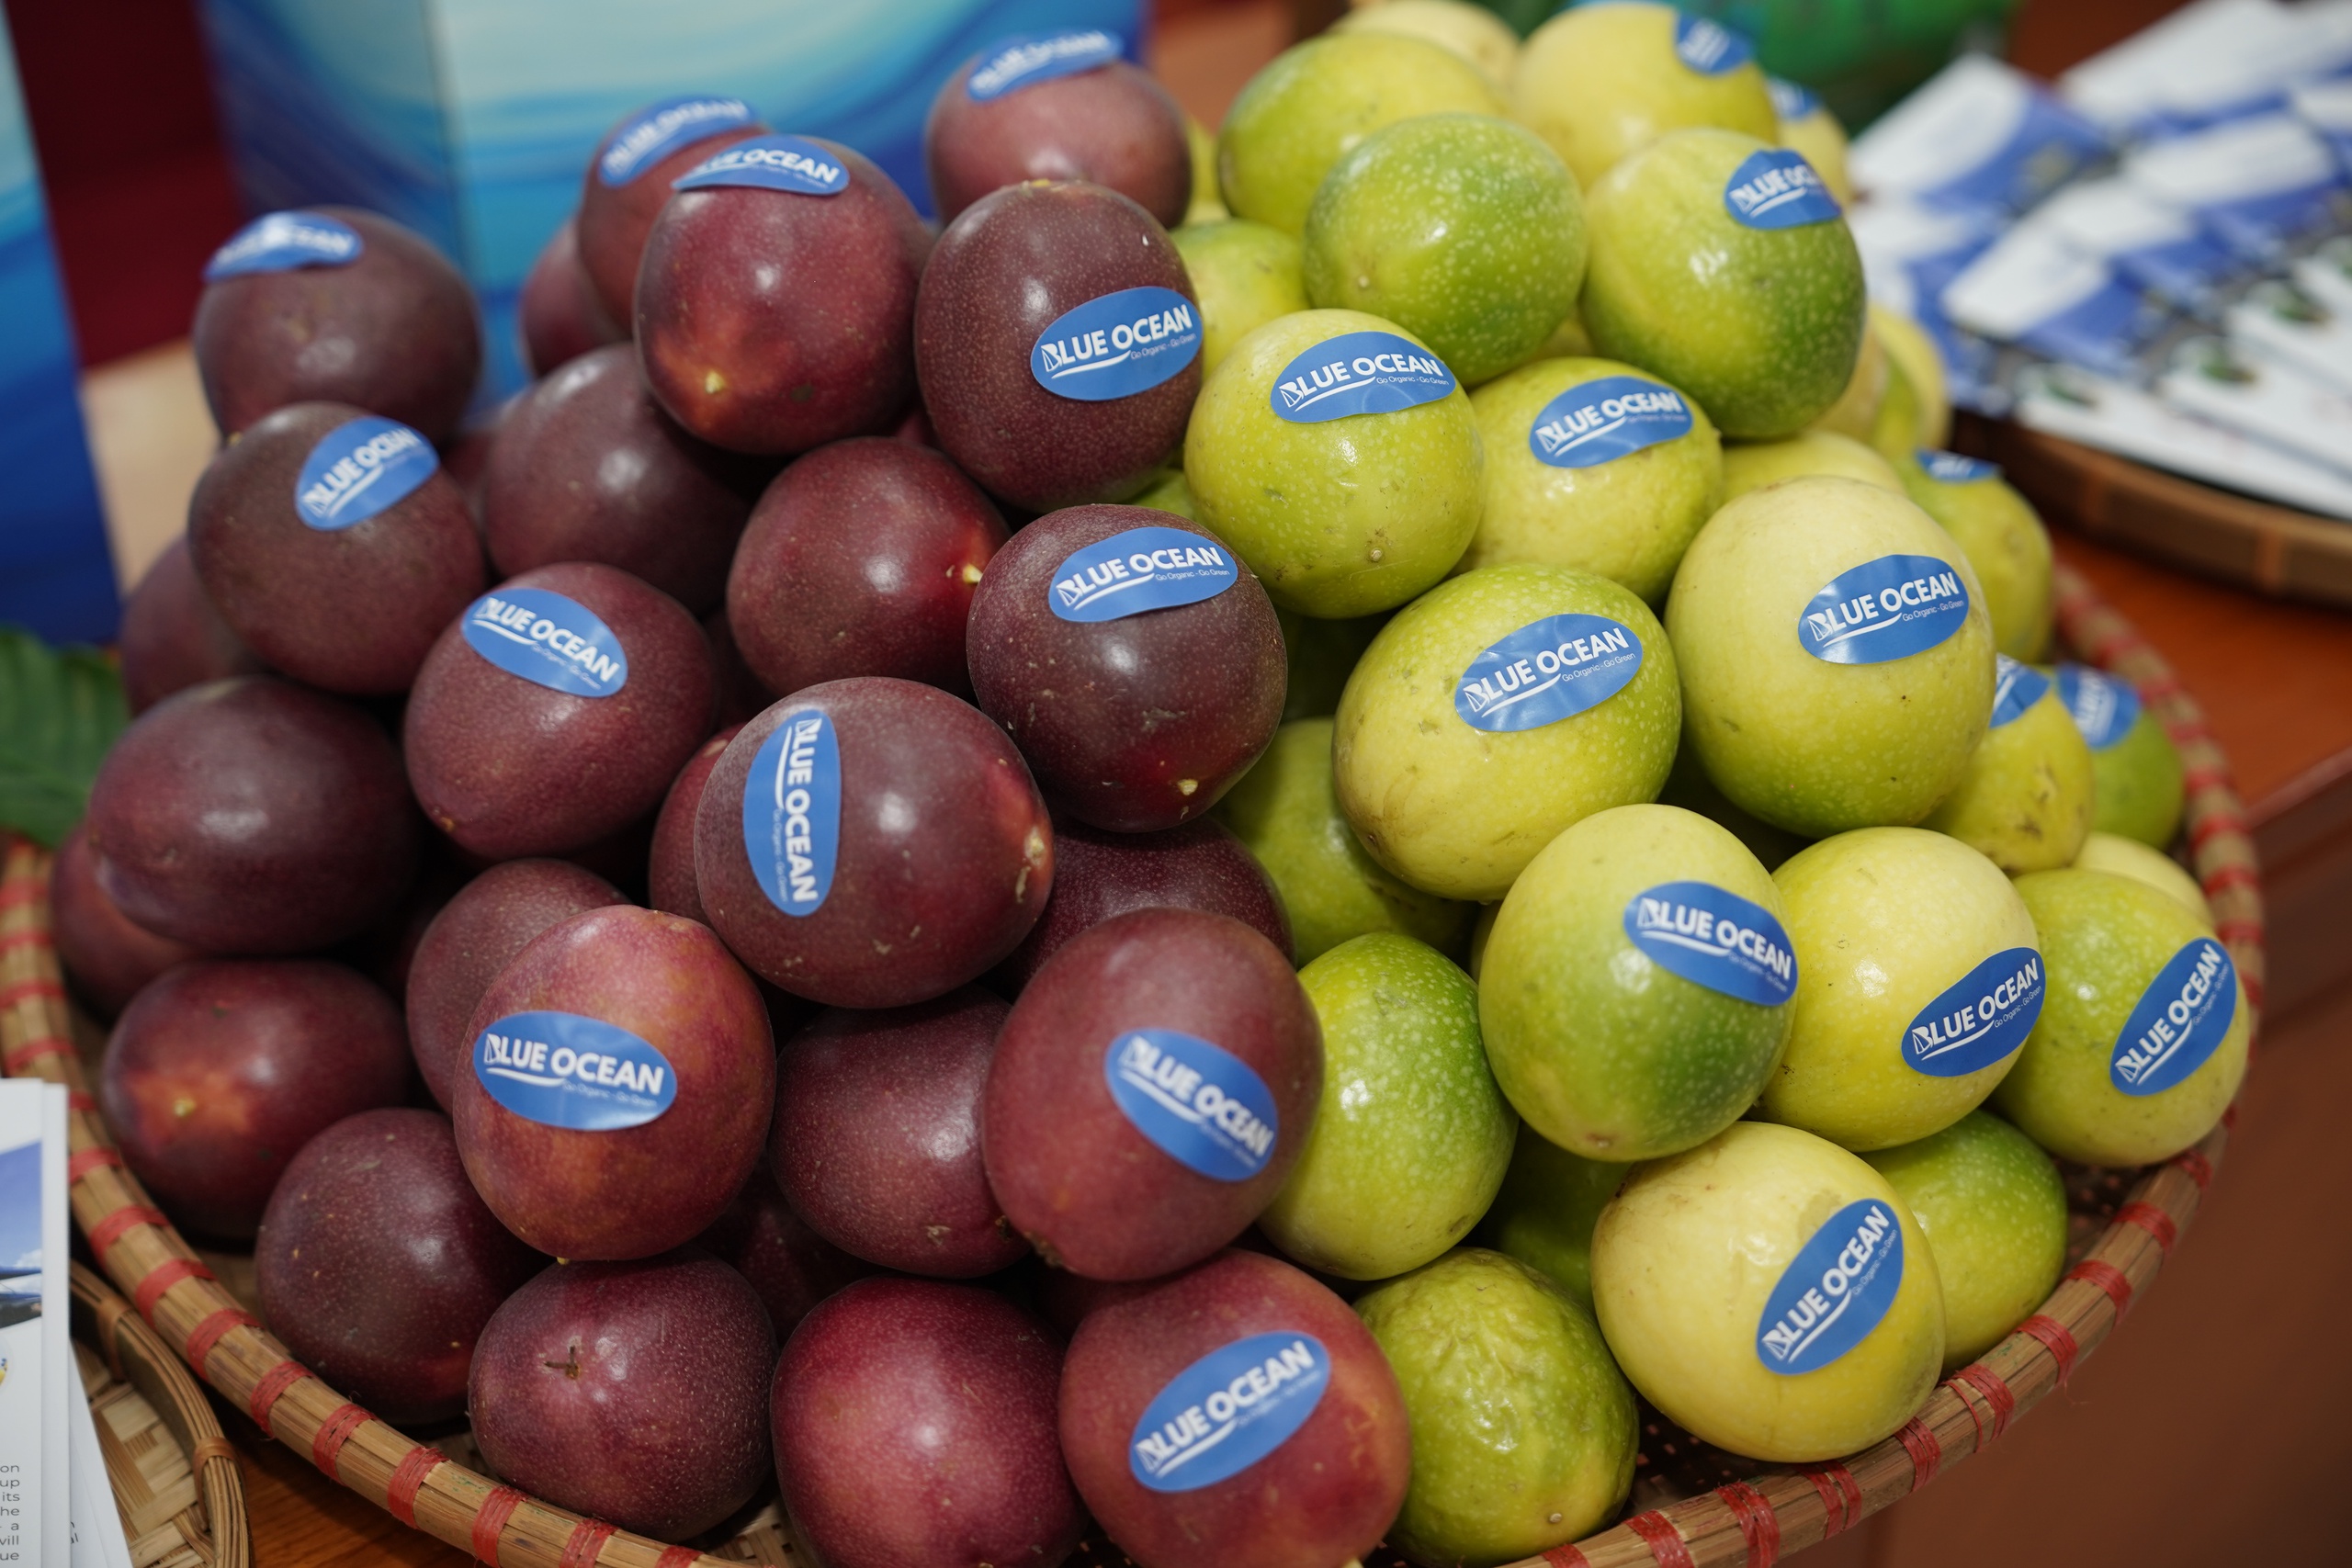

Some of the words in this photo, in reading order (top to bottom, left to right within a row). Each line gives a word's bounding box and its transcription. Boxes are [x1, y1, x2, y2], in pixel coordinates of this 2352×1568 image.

[743, 149, 841, 183] OCEAN
[1729, 168, 1791, 214] BLUE
[1040, 329, 1109, 372] BLUE
[1111, 304, 1193, 350] OCEAN
[1278, 361, 1351, 408] BLUE
[1351, 354, 1444, 377] OCEAN
[1430, 377, 1450, 385] Green
[1535, 404, 1605, 453] BLUE
[1600, 391, 1683, 419] OCEAN
[1056, 558, 1130, 607] BLUE
[1129, 547, 1225, 573] OCEAN
[1155, 573, 1168, 581] Go
[1167, 571, 1194, 581] Organic
[1806, 593, 1880, 642] BLUE
[1879, 571, 1960, 612] OCEAN
[473, 597, 537, 632] BLUE
[529, 619, 621, 682] OCEAN
[1902, 614, 1914, 622] Go
[1913, 606, 1938, 618] Organic
[1939, 603, 1949, 611] Go
[1948, 600, 1964, 609] Green
[1463, 659, 1537, 713] BLUE
[1536, 627, 1630, 674] OCEAN
[1562, 673, 1574, 682] Go
[1573, 664, 1600, 677] Organic
[1603, 660, 1615, 668] Go
[1614, 652, 1636, 664] Green
[787, 717, 822, 786] BLUE
[785, 788, 819, 902] OCEAN
[1636, 897, 1714, 941] BLUE
[1715, 919, 1792, 981] OCEAN
[1911, 1005, 1976, 1055] BLUE
[1978, 957, 2039, 1021] OCEAN
[1994, 1019, 2004, 1028] Go
[2003, 1004, 2021, 1022] Organic
[2022, 997, 2030, 1006] Go
[2029, 986, 2041, 1000] Green
[2115, 1017, 2176, 1083] BLUE
[2168, 942, 2222, 1025] OCEAN
[484, 1032, 548, 1072] BLUE
[550, 1046, 664, 1095] OCEAN
[1118, 1034, 1203, 1102] BLUE
[1194, 1084, 1274, 1157] OCEAN
[1761, 1287, 1831, 1360] BLUE
[1822, 1205, 1890, 1297] OCEAN
[1135, 1405, 1212, 1473] BLUE
[1205, 1339, 1315, 1422] OCEAN
[3, 1492, 20, 1502] its
